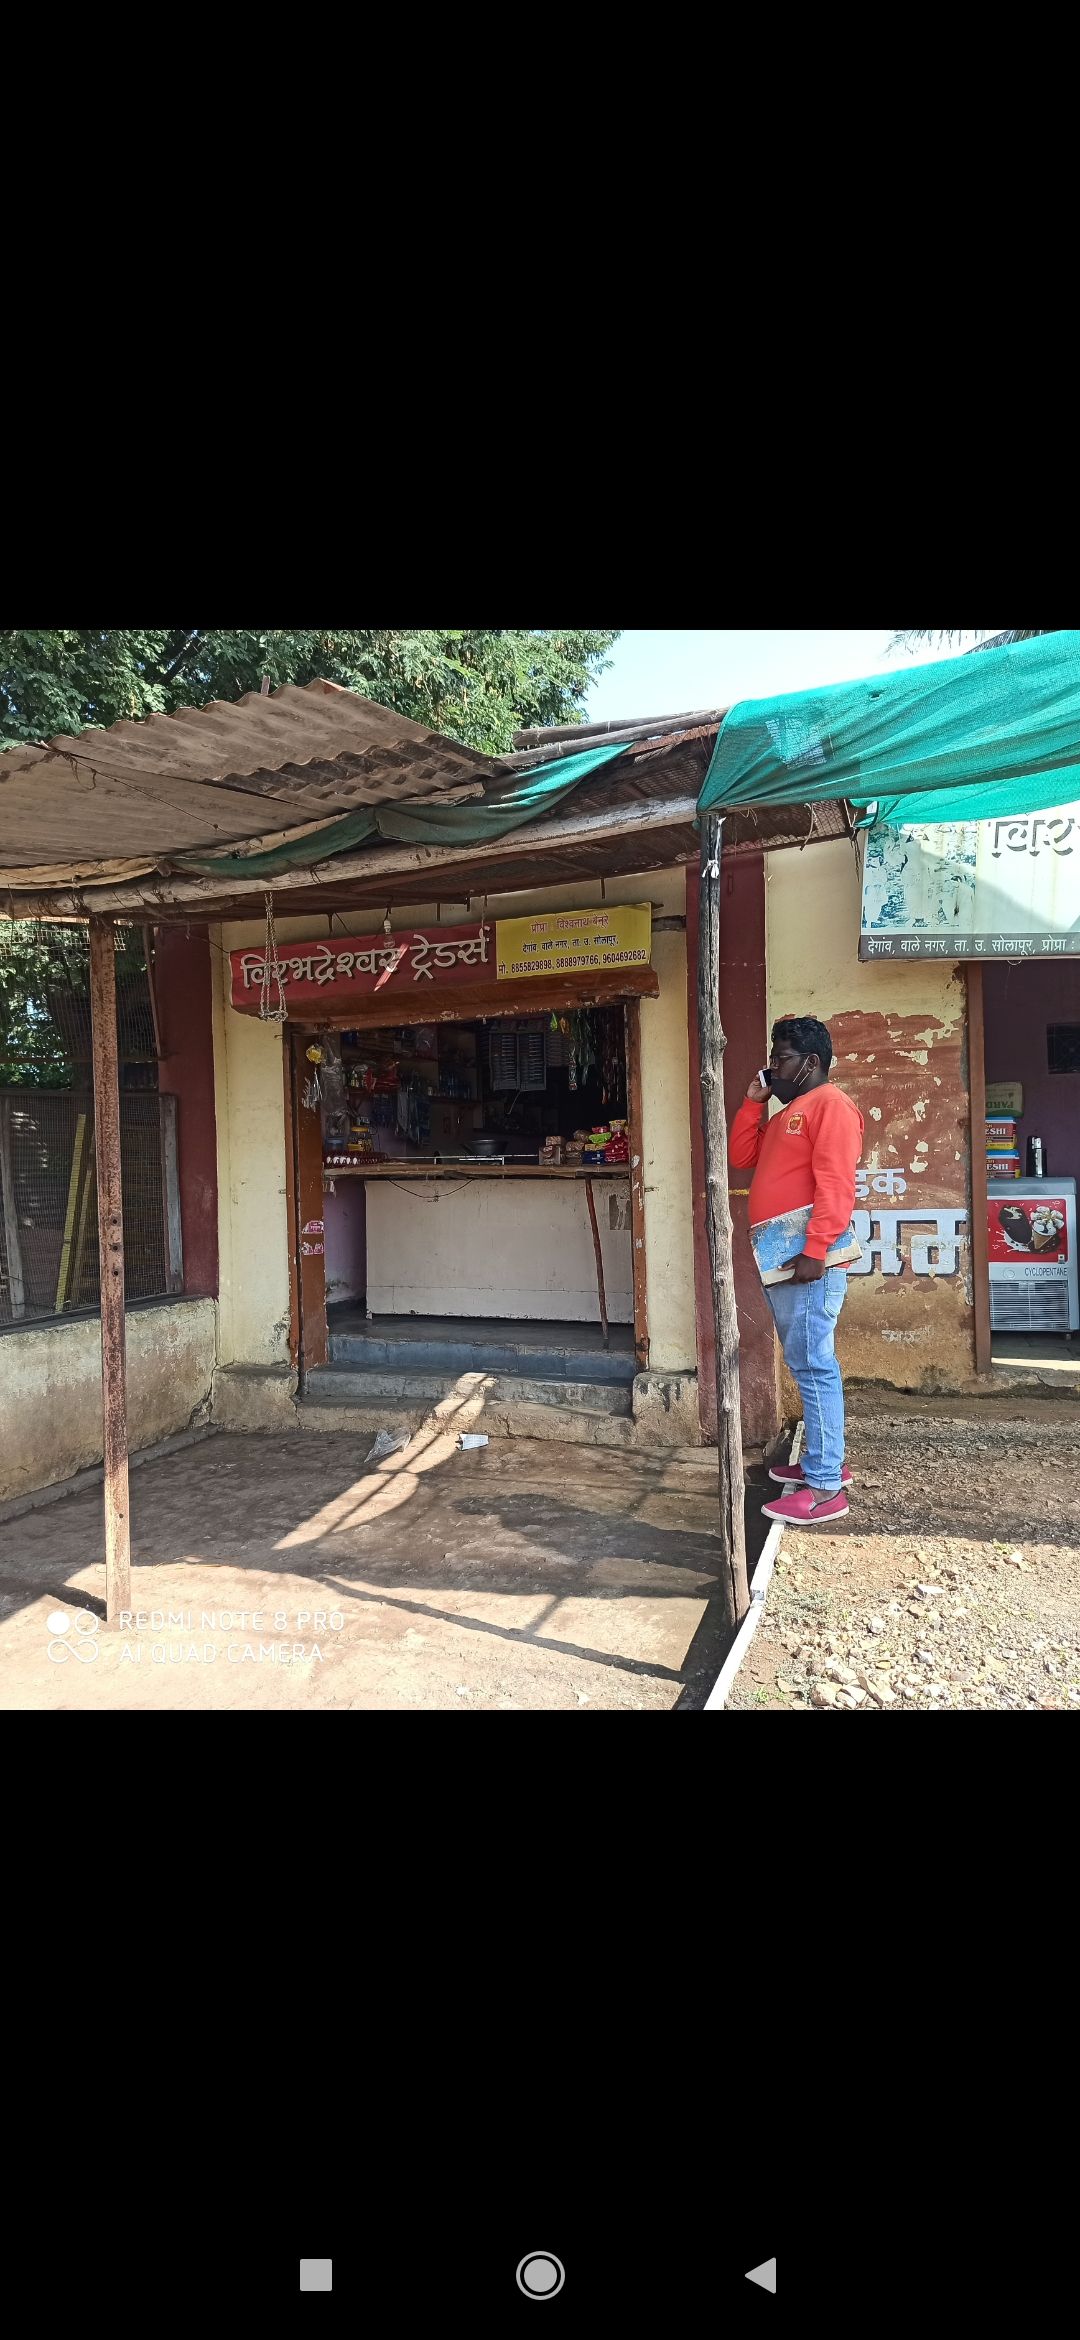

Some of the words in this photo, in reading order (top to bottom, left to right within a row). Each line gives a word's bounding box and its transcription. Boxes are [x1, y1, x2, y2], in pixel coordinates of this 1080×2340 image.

[867, 935, 895, 954] देगांव,
[900, 935, 921, 952] वाले
[924, 939, 949, 954] नगर,
[954, 939, 969, 952] ता.
[974, 939, 986, 952] उ.
[991, 934, 1036, 955] सोलापूर,
[1024, 1267, 1068, 1277] CYCLOPENTANE
